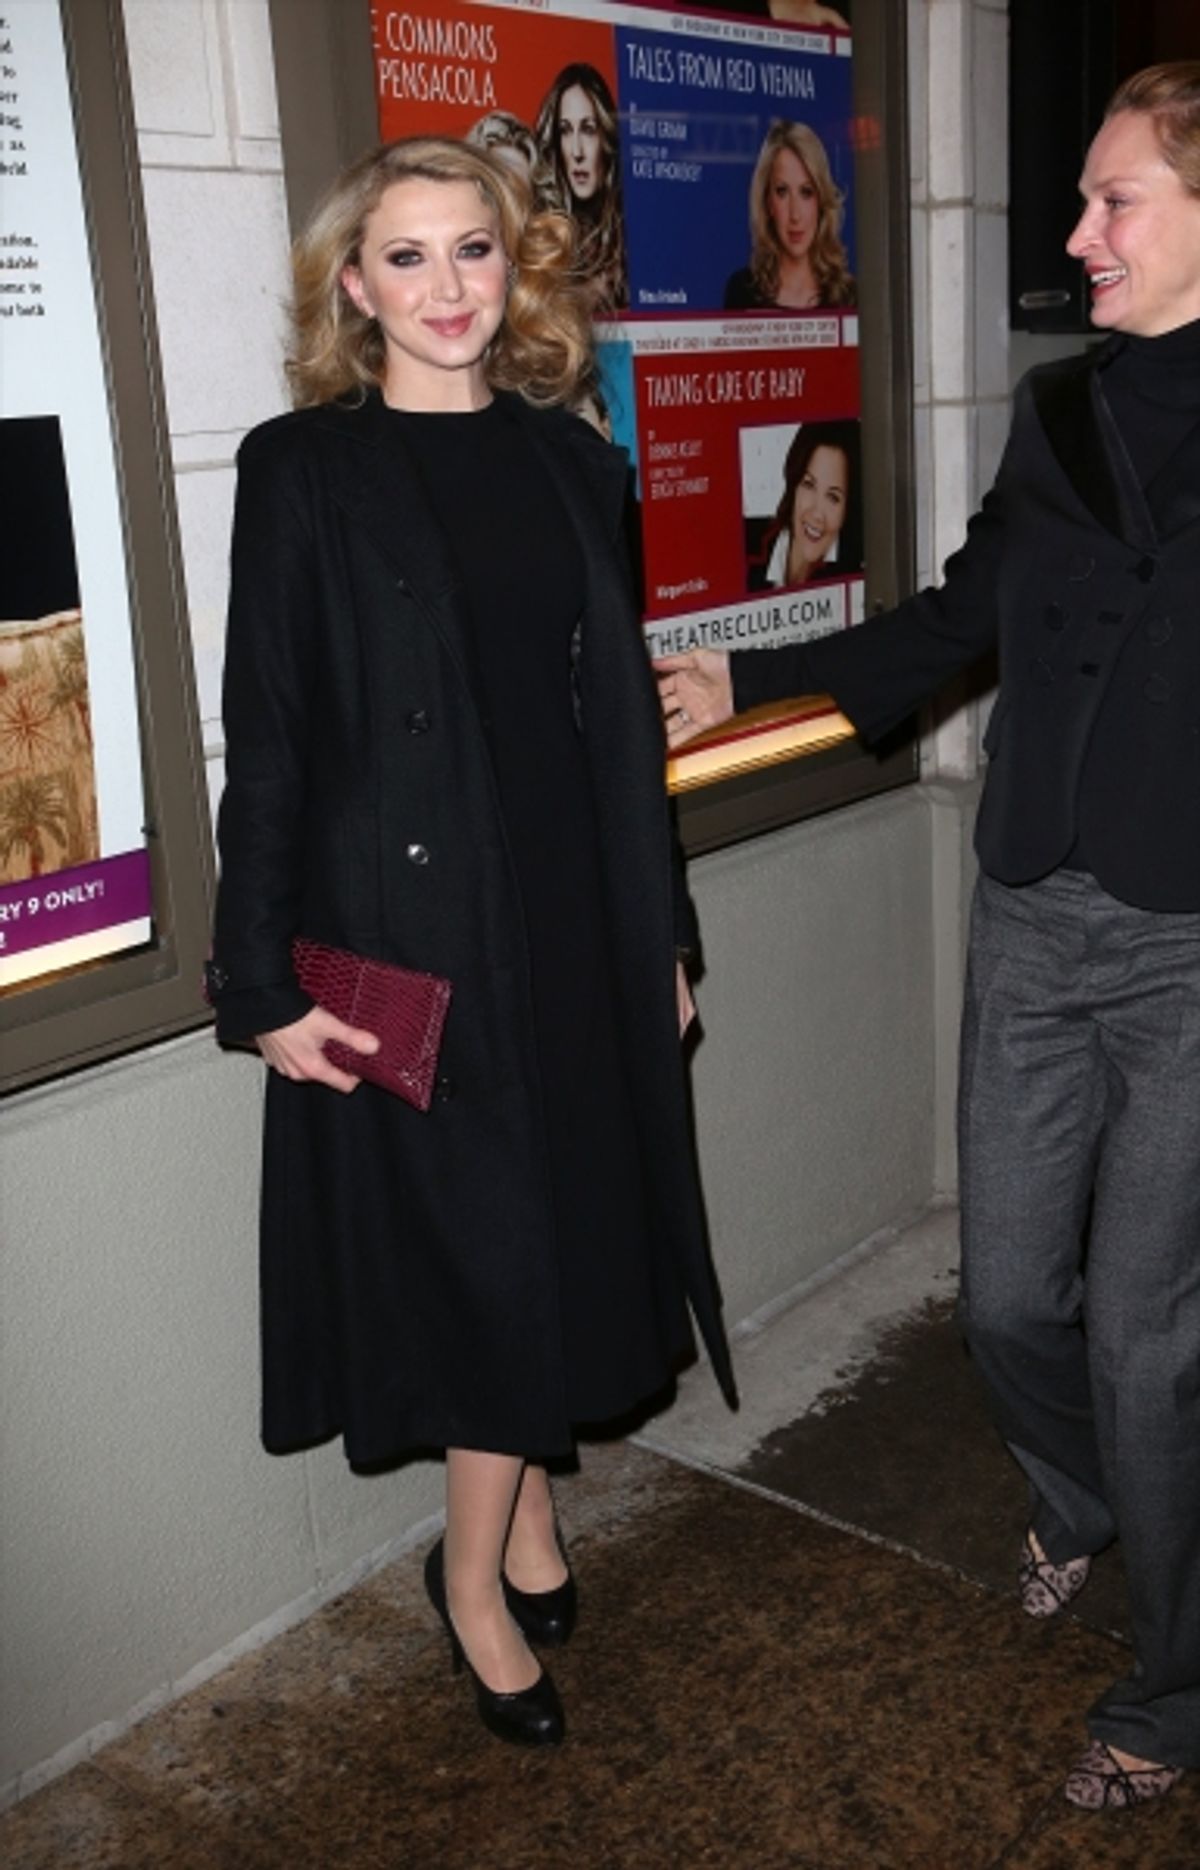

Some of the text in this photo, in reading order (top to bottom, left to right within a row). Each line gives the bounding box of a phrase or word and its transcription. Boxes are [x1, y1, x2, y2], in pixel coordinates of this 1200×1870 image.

[386, 12, 497, 64] COMMONS
[379, 58, 497, 107] PENSACOLA
[626, 43, 816, 99] TALES FROM RED VIENNA
[644, 366, 806, 408] TAKING CARE OF BABY
[27, 897, 40, 915] 9
[44, 879, 105, 912] ONLY!
